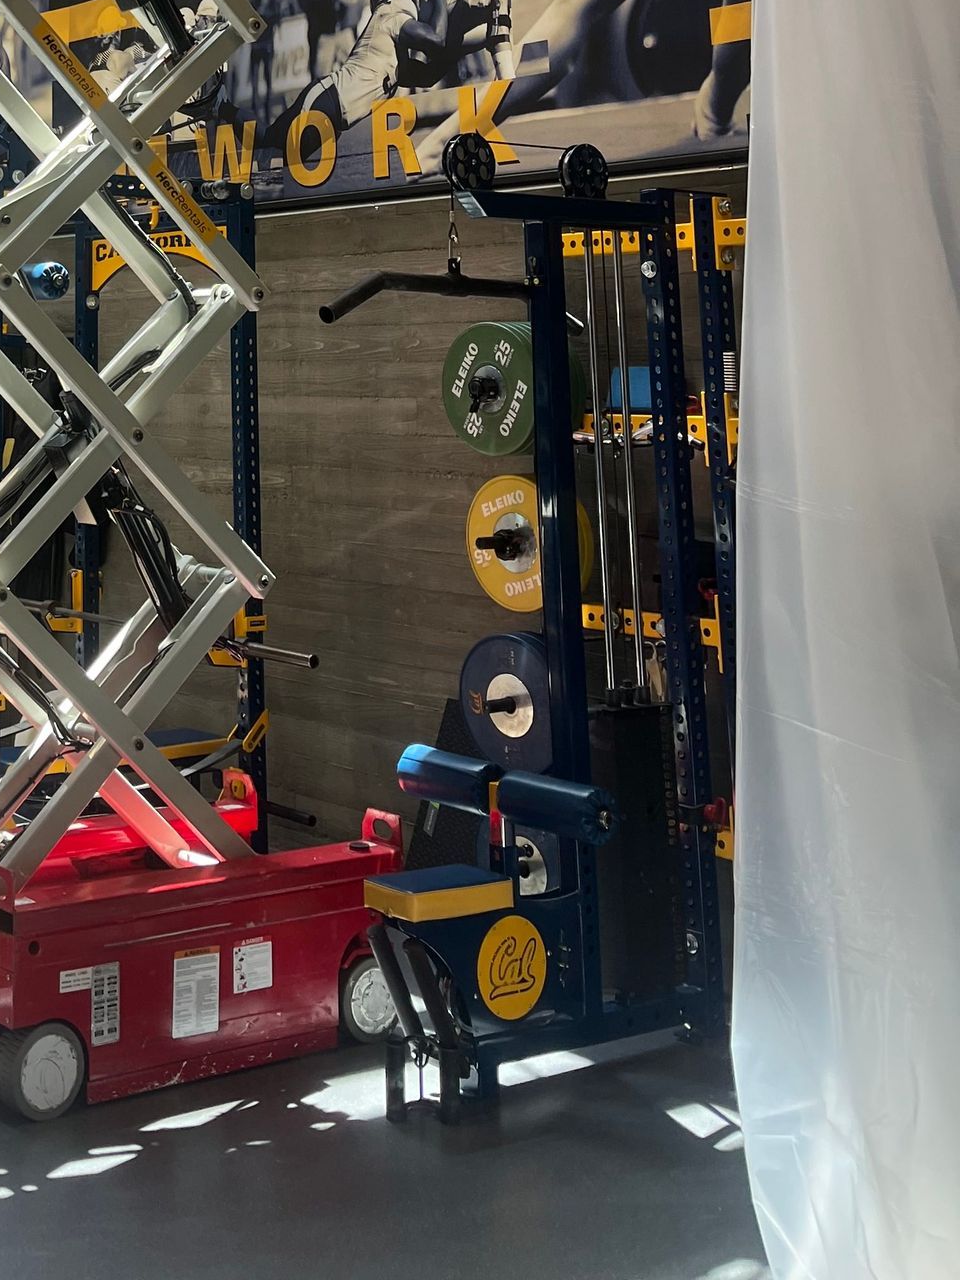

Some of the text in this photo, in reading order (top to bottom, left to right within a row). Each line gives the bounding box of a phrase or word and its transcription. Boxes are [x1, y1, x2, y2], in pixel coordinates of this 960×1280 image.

[451, 342, 478, 398] ELEIKO
[495, 339, 512, 366] 25
[499, 379, 528, 436] ELEIKO
[481, 489, 524, 517] ELEIKO
[504, 572, 541, 597] LEIKO
[489, 936, 537, 1001] Cal
